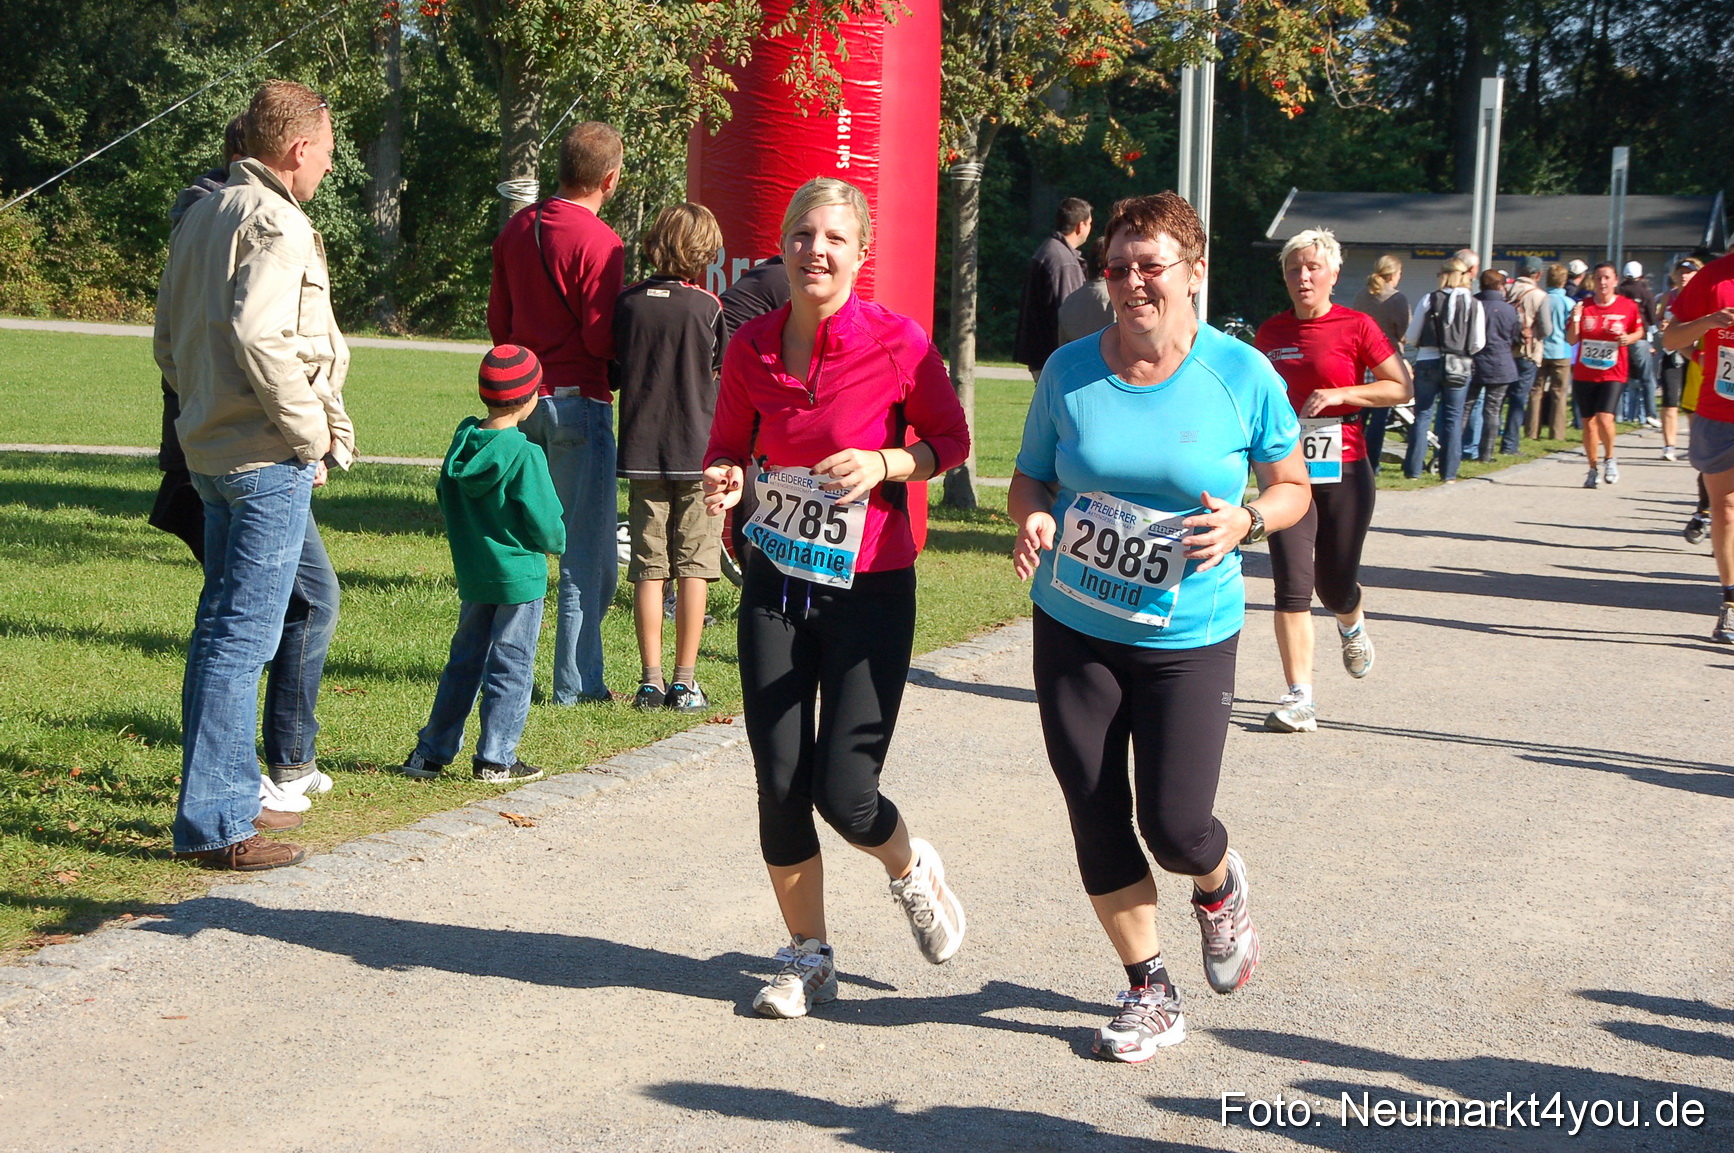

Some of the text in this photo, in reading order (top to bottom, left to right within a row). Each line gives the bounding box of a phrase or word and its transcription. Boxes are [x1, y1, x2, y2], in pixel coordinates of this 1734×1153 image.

[836, 108, 852, 169] Seit 1929
[1584, 347, 1614, 360] 3248
[1722, 361, 1734, 380] 2
[1303, 436, 1332, 460] 67
[769, 472, 814, 490] PFLEIDERER
[762, 489, 849, 545] 2785
[1090, 500, 1137, 526] PFLEIDERER
[751, 526, 845, 572] Stephanie
[1070, 518, 1173, 585] 2985
[1080, 567, 1143, 607] Ingrid
